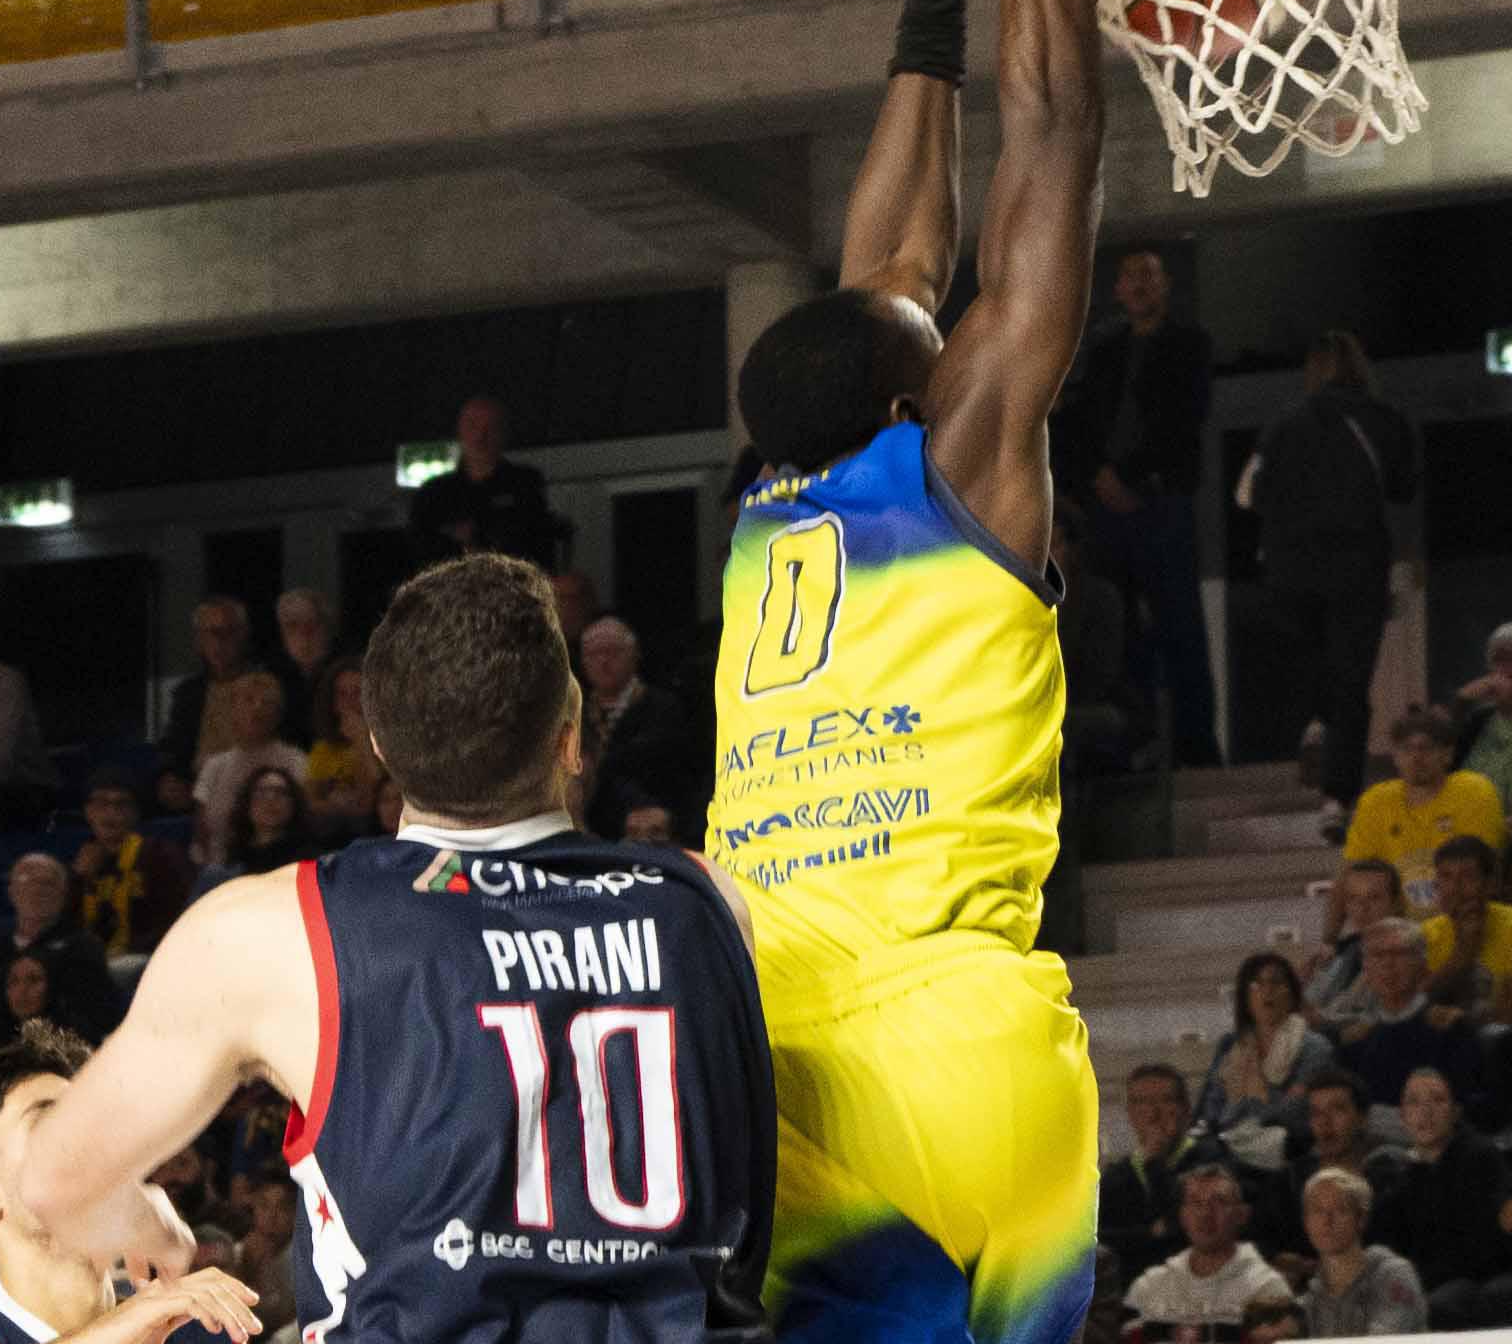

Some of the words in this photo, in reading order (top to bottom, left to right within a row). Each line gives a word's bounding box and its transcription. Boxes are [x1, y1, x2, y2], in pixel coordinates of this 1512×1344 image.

[719, 706, 877, 778] AFLEX
[482, 917, 662, 995] PIRANI
[475, 1000, 686, 1232] 10
